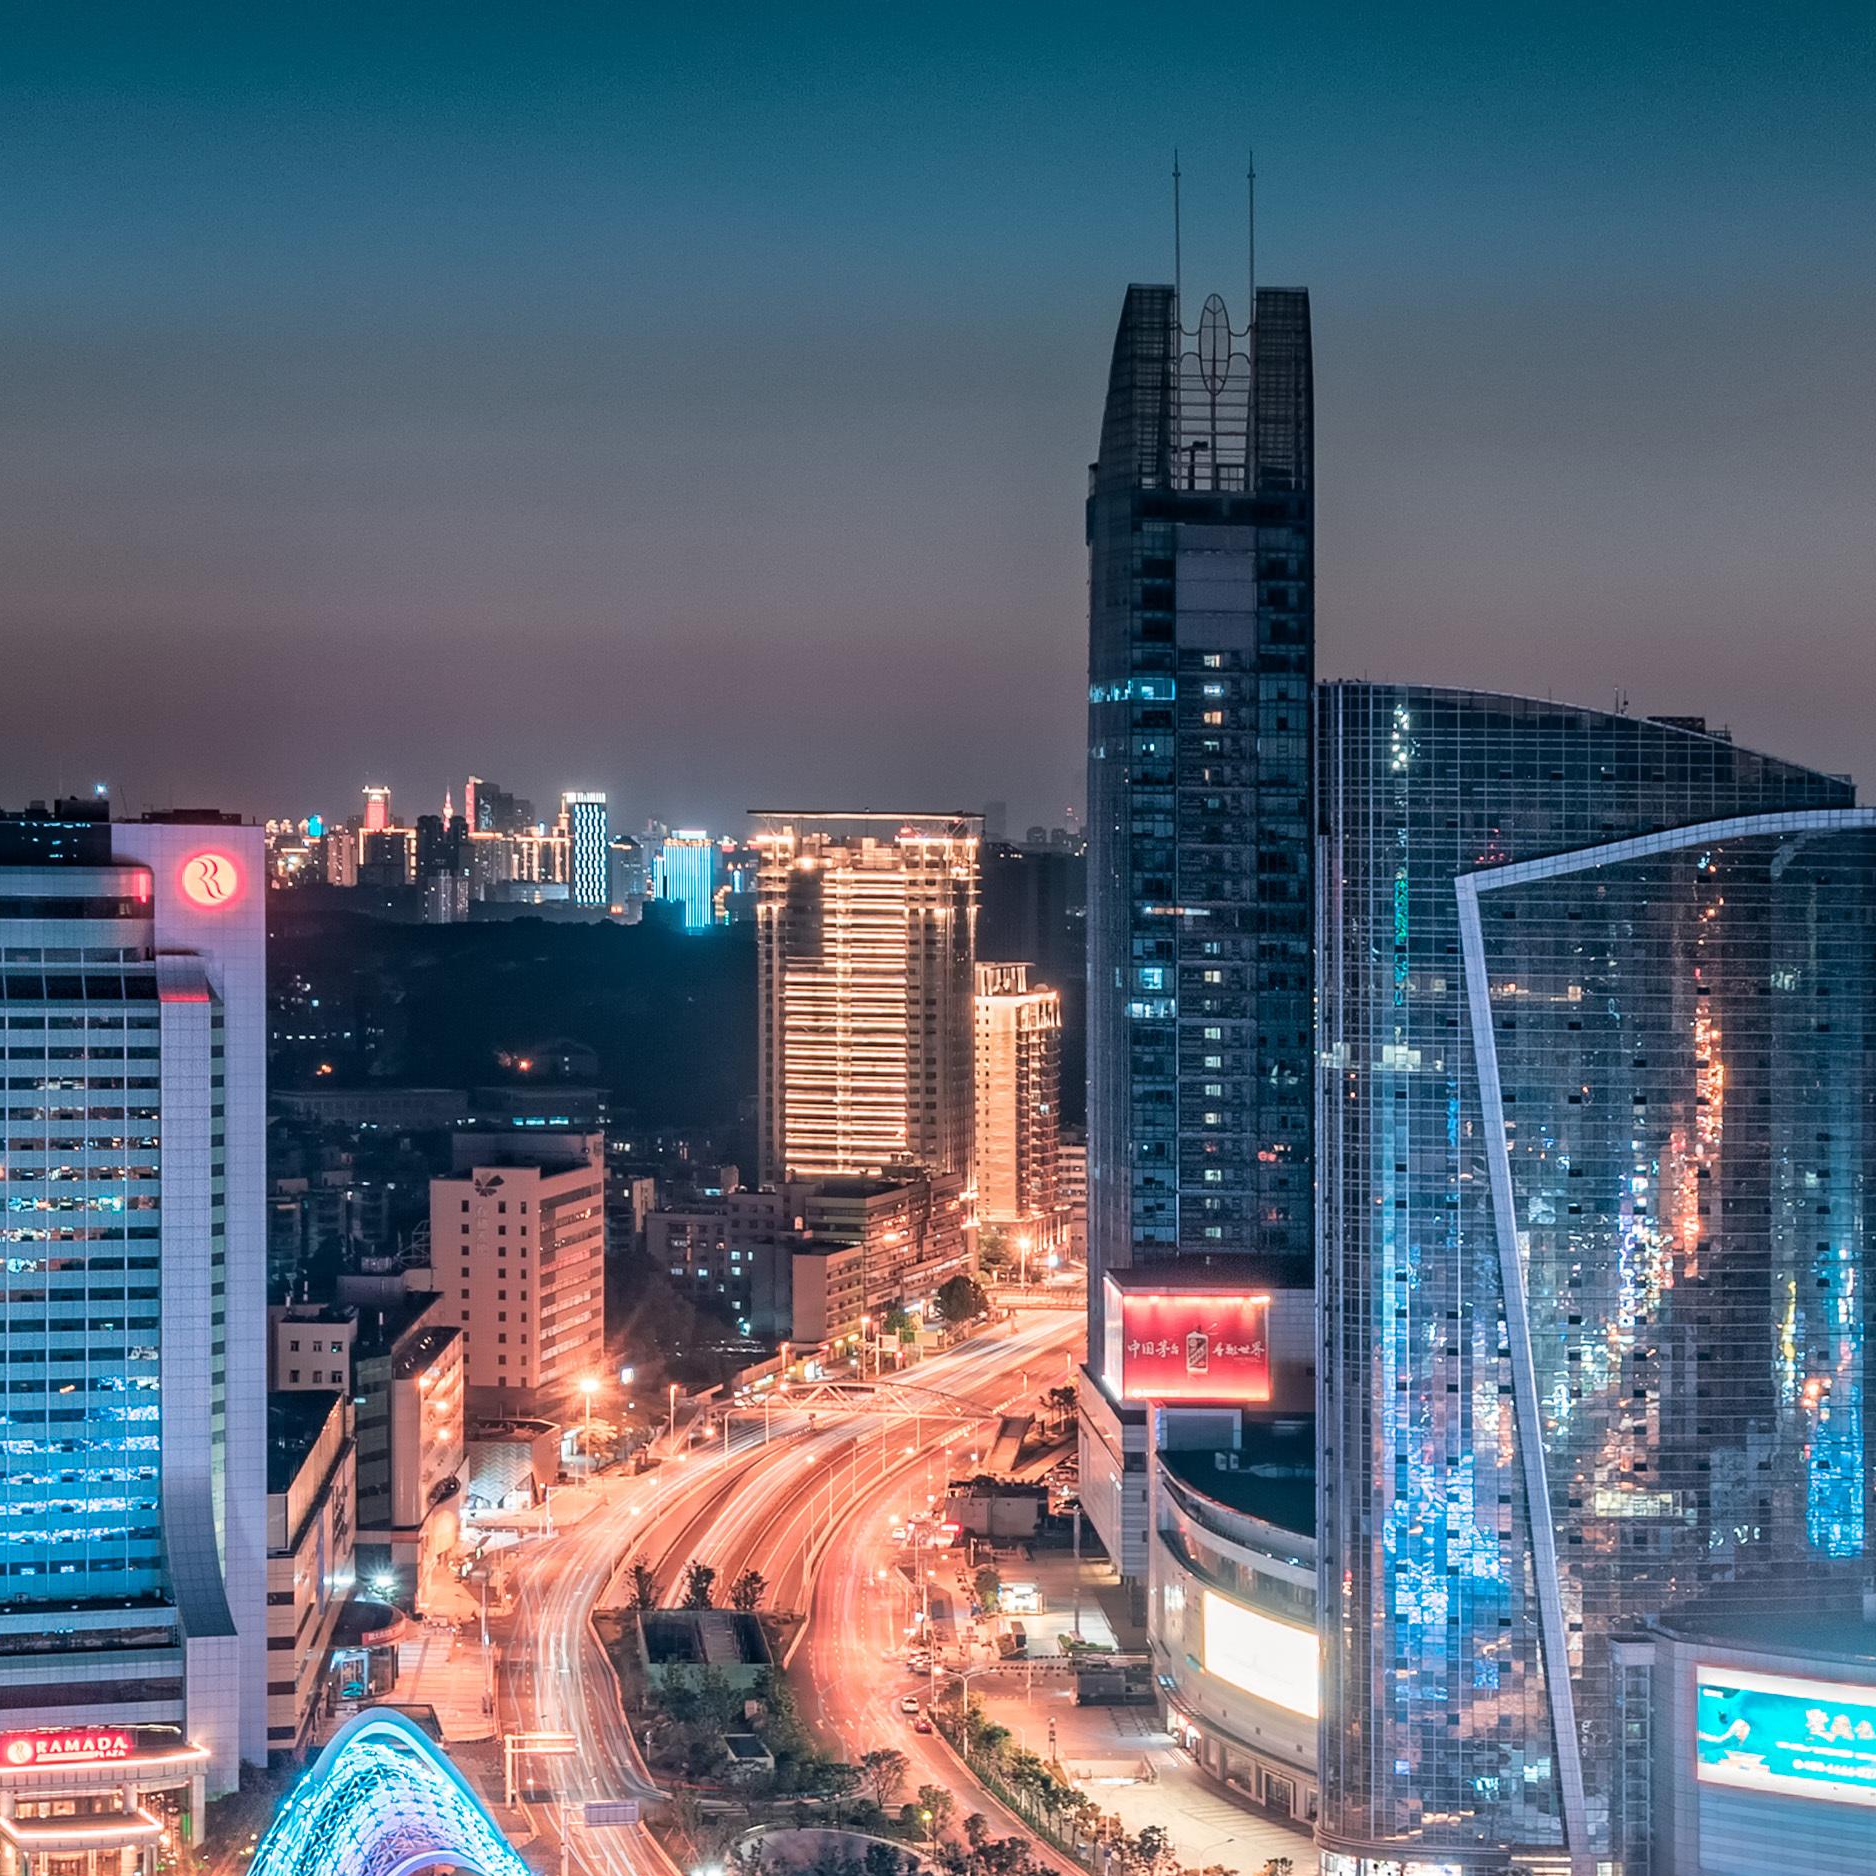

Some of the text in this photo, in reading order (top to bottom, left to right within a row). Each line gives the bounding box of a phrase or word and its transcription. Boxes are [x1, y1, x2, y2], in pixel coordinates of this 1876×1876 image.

[1127, 1340, 1180, 1358] 中国茅台
[36, 1737, 127, 1753] RAMADA
